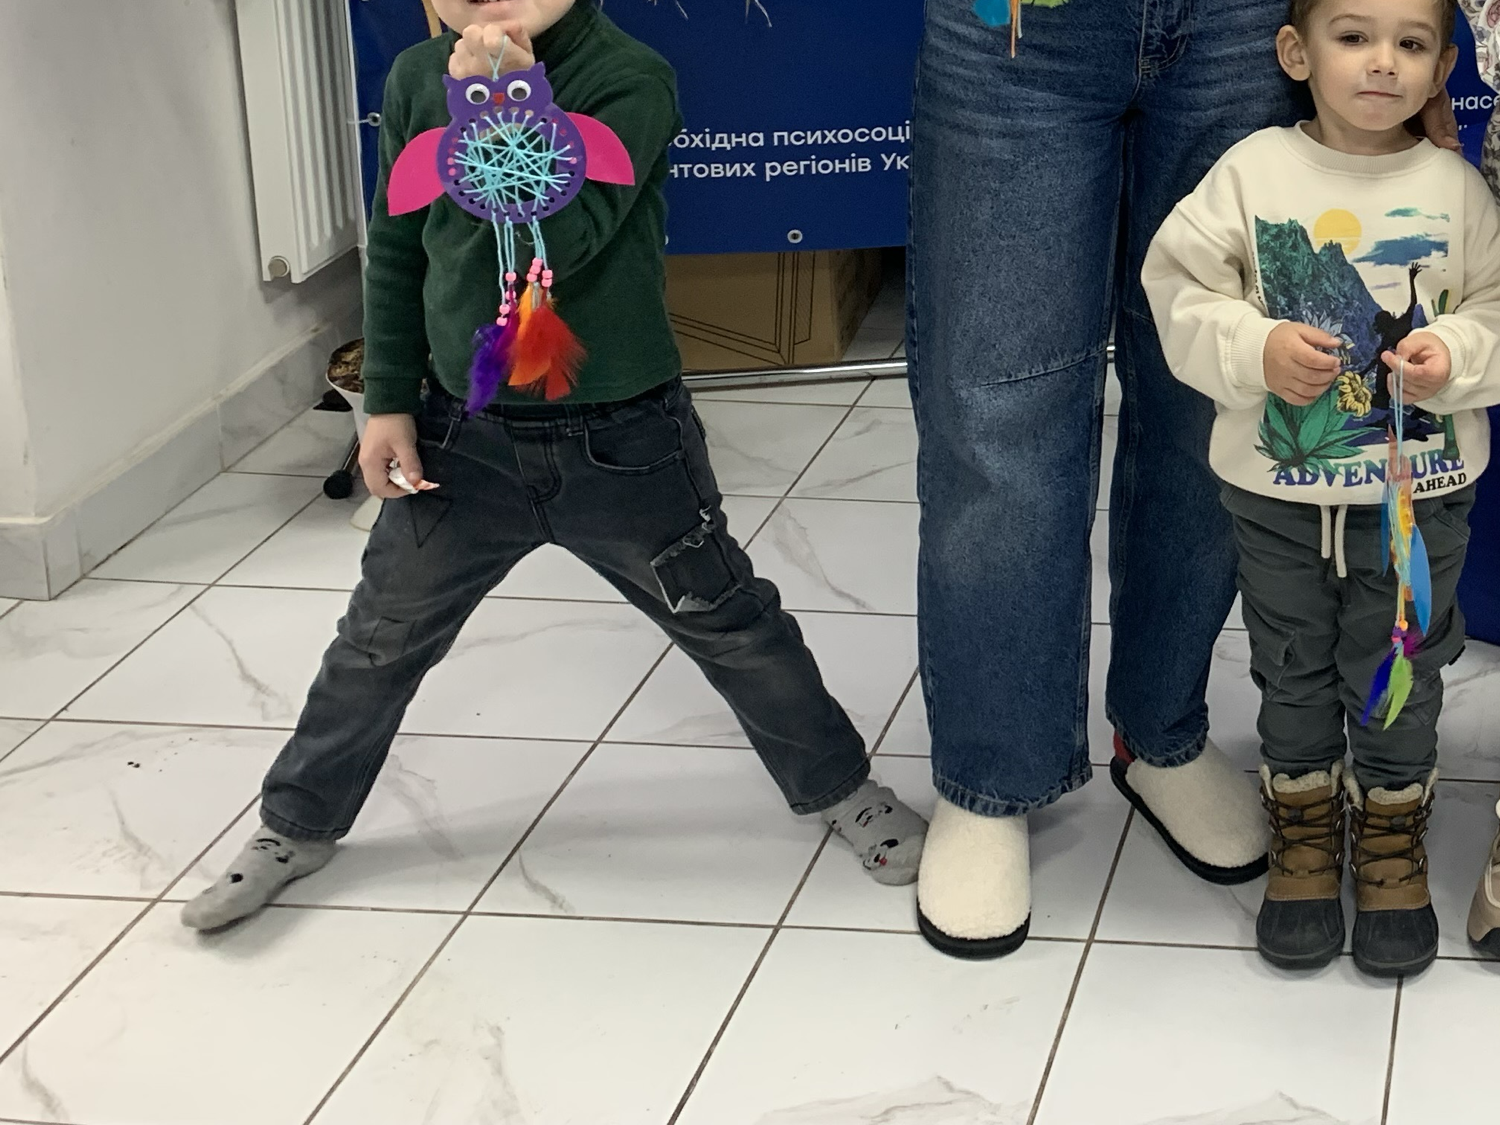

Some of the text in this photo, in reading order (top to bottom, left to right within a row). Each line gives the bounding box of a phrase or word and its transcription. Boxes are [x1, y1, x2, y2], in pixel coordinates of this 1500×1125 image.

[668, 120, 911, 151] бхідна психосоці
[669, 153, 910, 182] нтових регіонів Ук
[1272, 448, 1465, 488] ADVENURE
[1413, 472, 1467, 494] AHEAD
